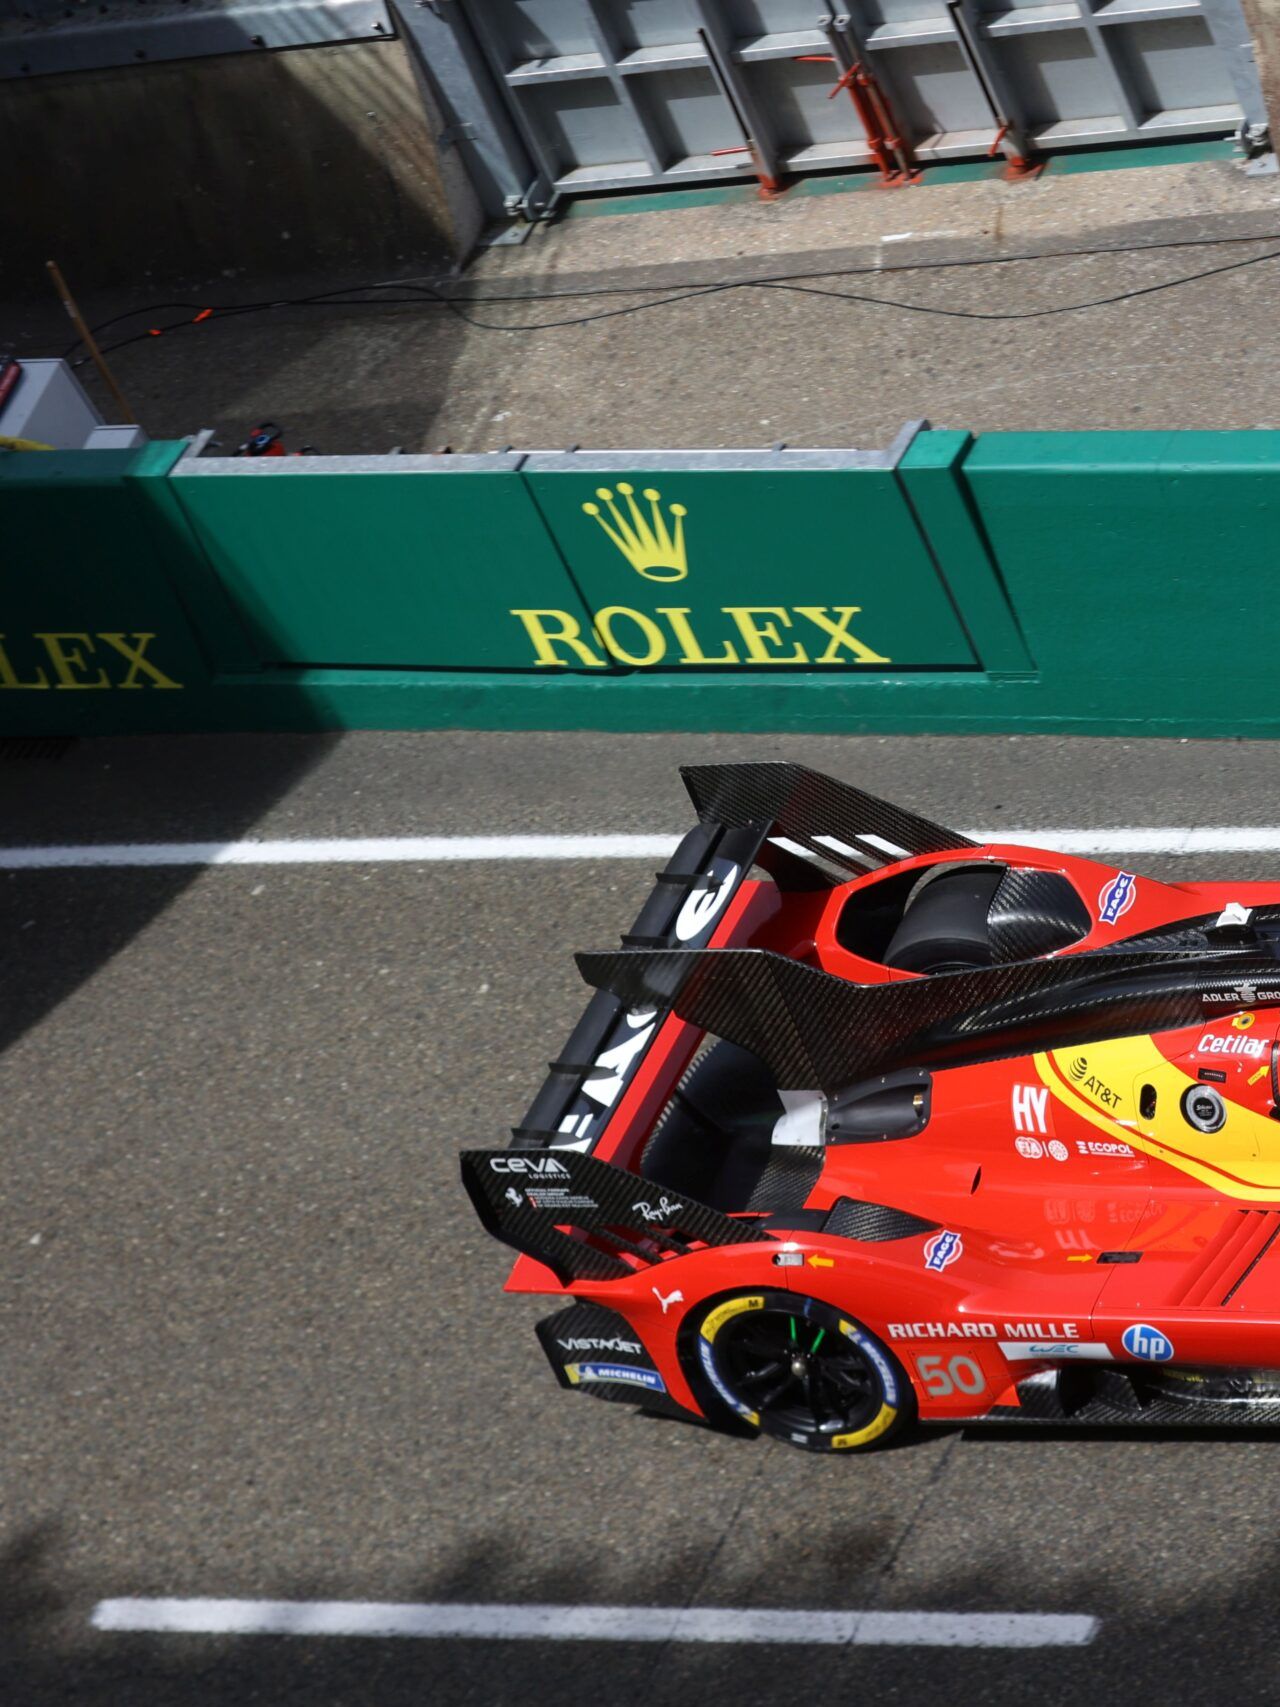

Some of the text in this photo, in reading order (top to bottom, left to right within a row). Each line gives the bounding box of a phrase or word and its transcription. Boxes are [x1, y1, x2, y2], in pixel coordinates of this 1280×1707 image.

[510, 606, 891, 667] ROLEX
[1202, 993, 1239, 1002] ADLER
[1198, 1033, 1269, 1056] Cetilar
[1084, 1075, 1122, 1109] AT&T
[1013, 1084, 1049, 1133] HY
[1087, 1141, 1135, 1156] ECOPOL
[632, 1196, 684, 1221] Ray-Ban
[887, 1323, 1079, 1338] RICHARD MILLE
[1133, 1324, 1166, 1360] hp
[597, 1369, 656, 1384] MICHELIN
[916, 1356, 985, 1396] 50
